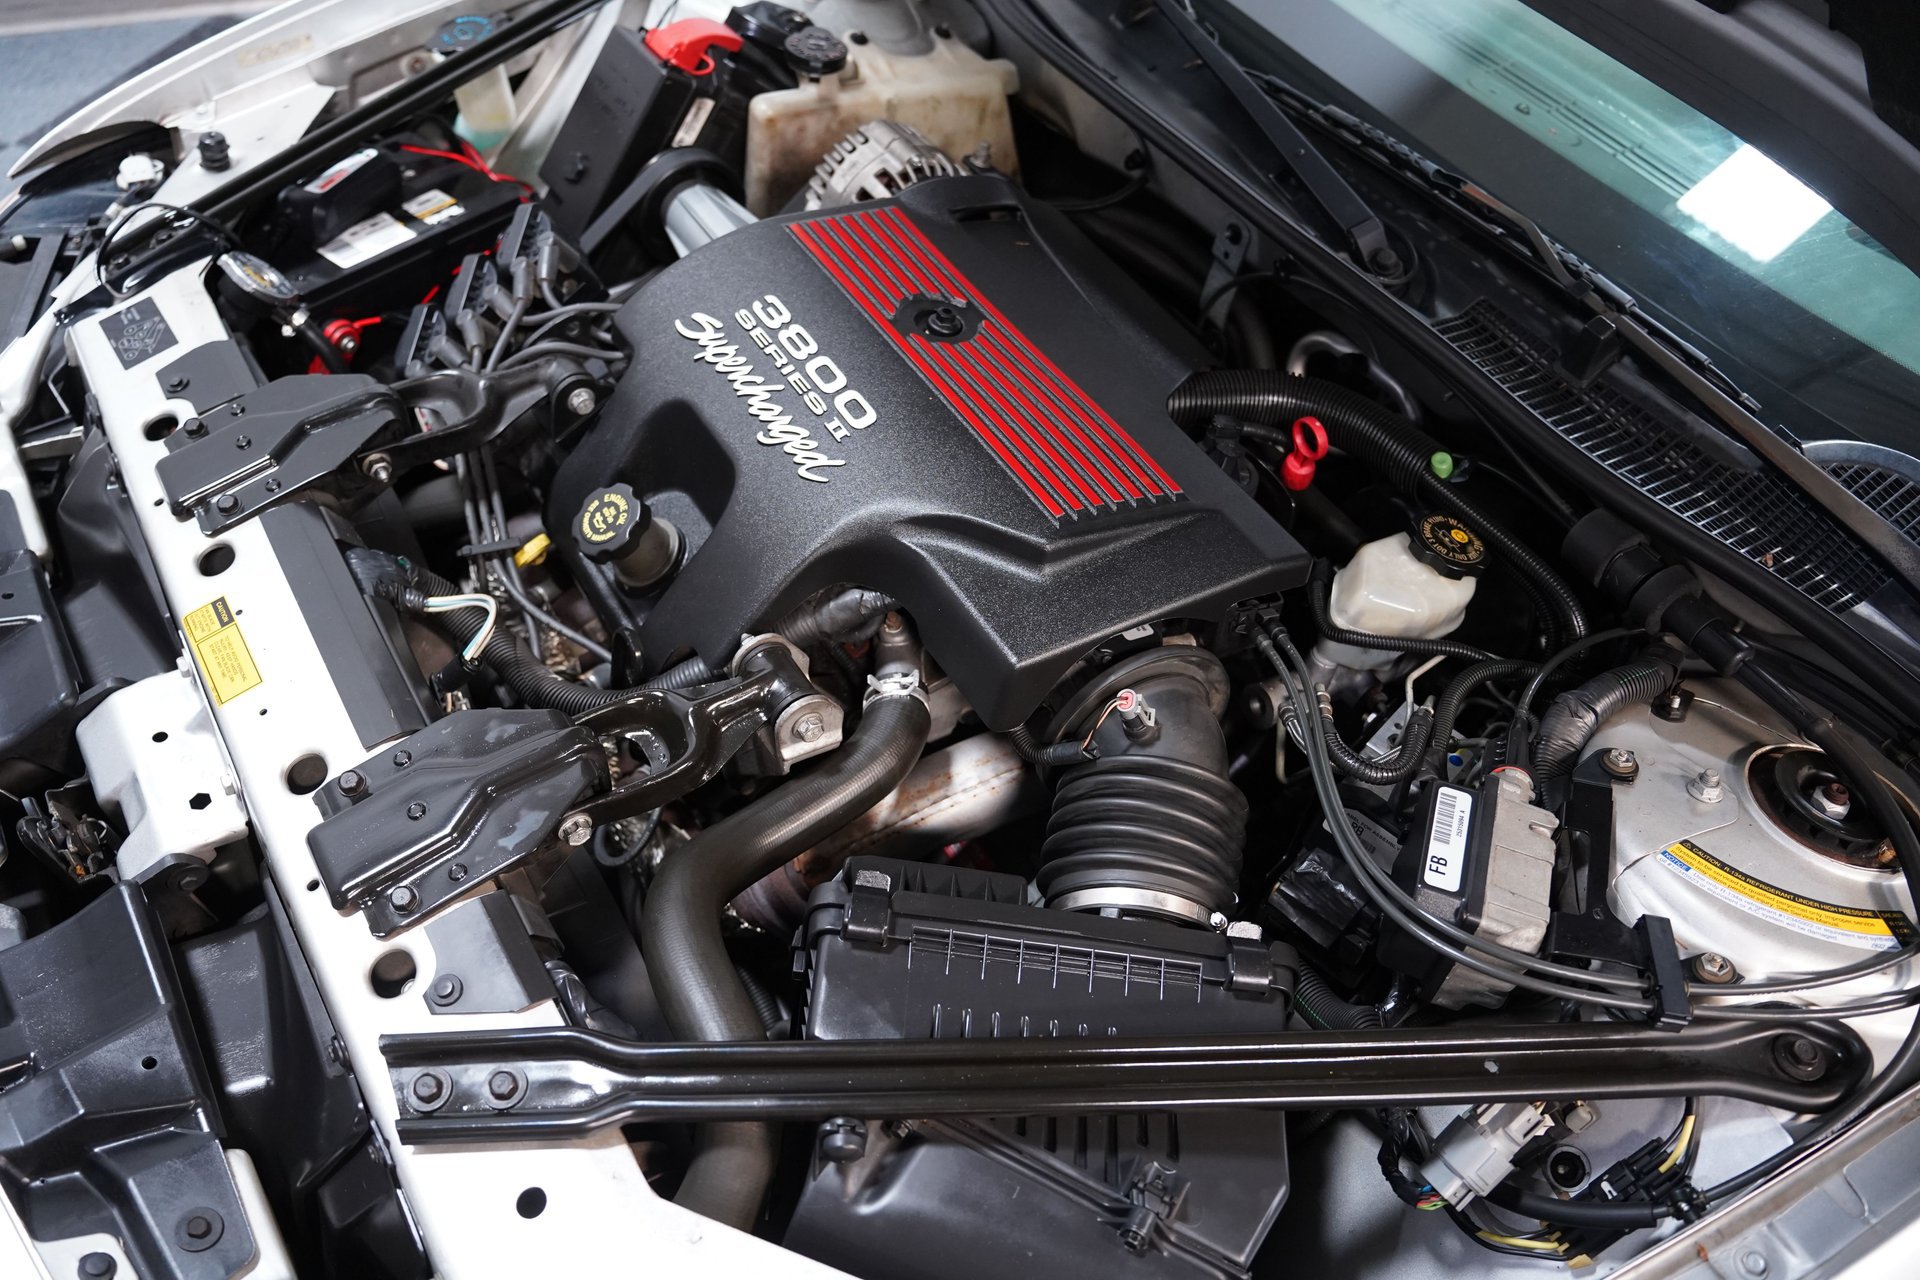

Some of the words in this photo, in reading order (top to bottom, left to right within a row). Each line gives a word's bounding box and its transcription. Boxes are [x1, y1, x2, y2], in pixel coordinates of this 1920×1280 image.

[734, 308, 828, 416] SERIES
[824, 416, 851, 443] II
[752, 294, 878, 429] 3800
[674, 312, 846, 483] Supercharged
[604, 493, 628, 512] ENGINE
[616, 512, 628, 526] OIL
[1433, 543, 1447, 554] DOT
[215, 601, 230, 622] CAUTION
[1346, 812, 1359, 823] ABEL
[1360, 822, 1372, 831] FOR
[1429, 855, 1447, 876] FB
[1664, 852, 1689, 870] NOTICE
[1676, 846, 1697, 862] System
[1713, 870, 1738, 885] serviced
[1693, 847, 1722, 867] CAUTION:
[1724, 866, 1746, 881] R-134a
[1746, 878, 1793, 901] REFRIGERANT
[1795, 895, 1820, 907] UNDER
[1820, 904, 1838, 912] HIGH
[1838, 907, 1874, 917] PRESSURE
[1695, 865, 1707, 875] may
[1728, 884, 1755, 899] personal
[1790, 909, 1812, 922] Service
